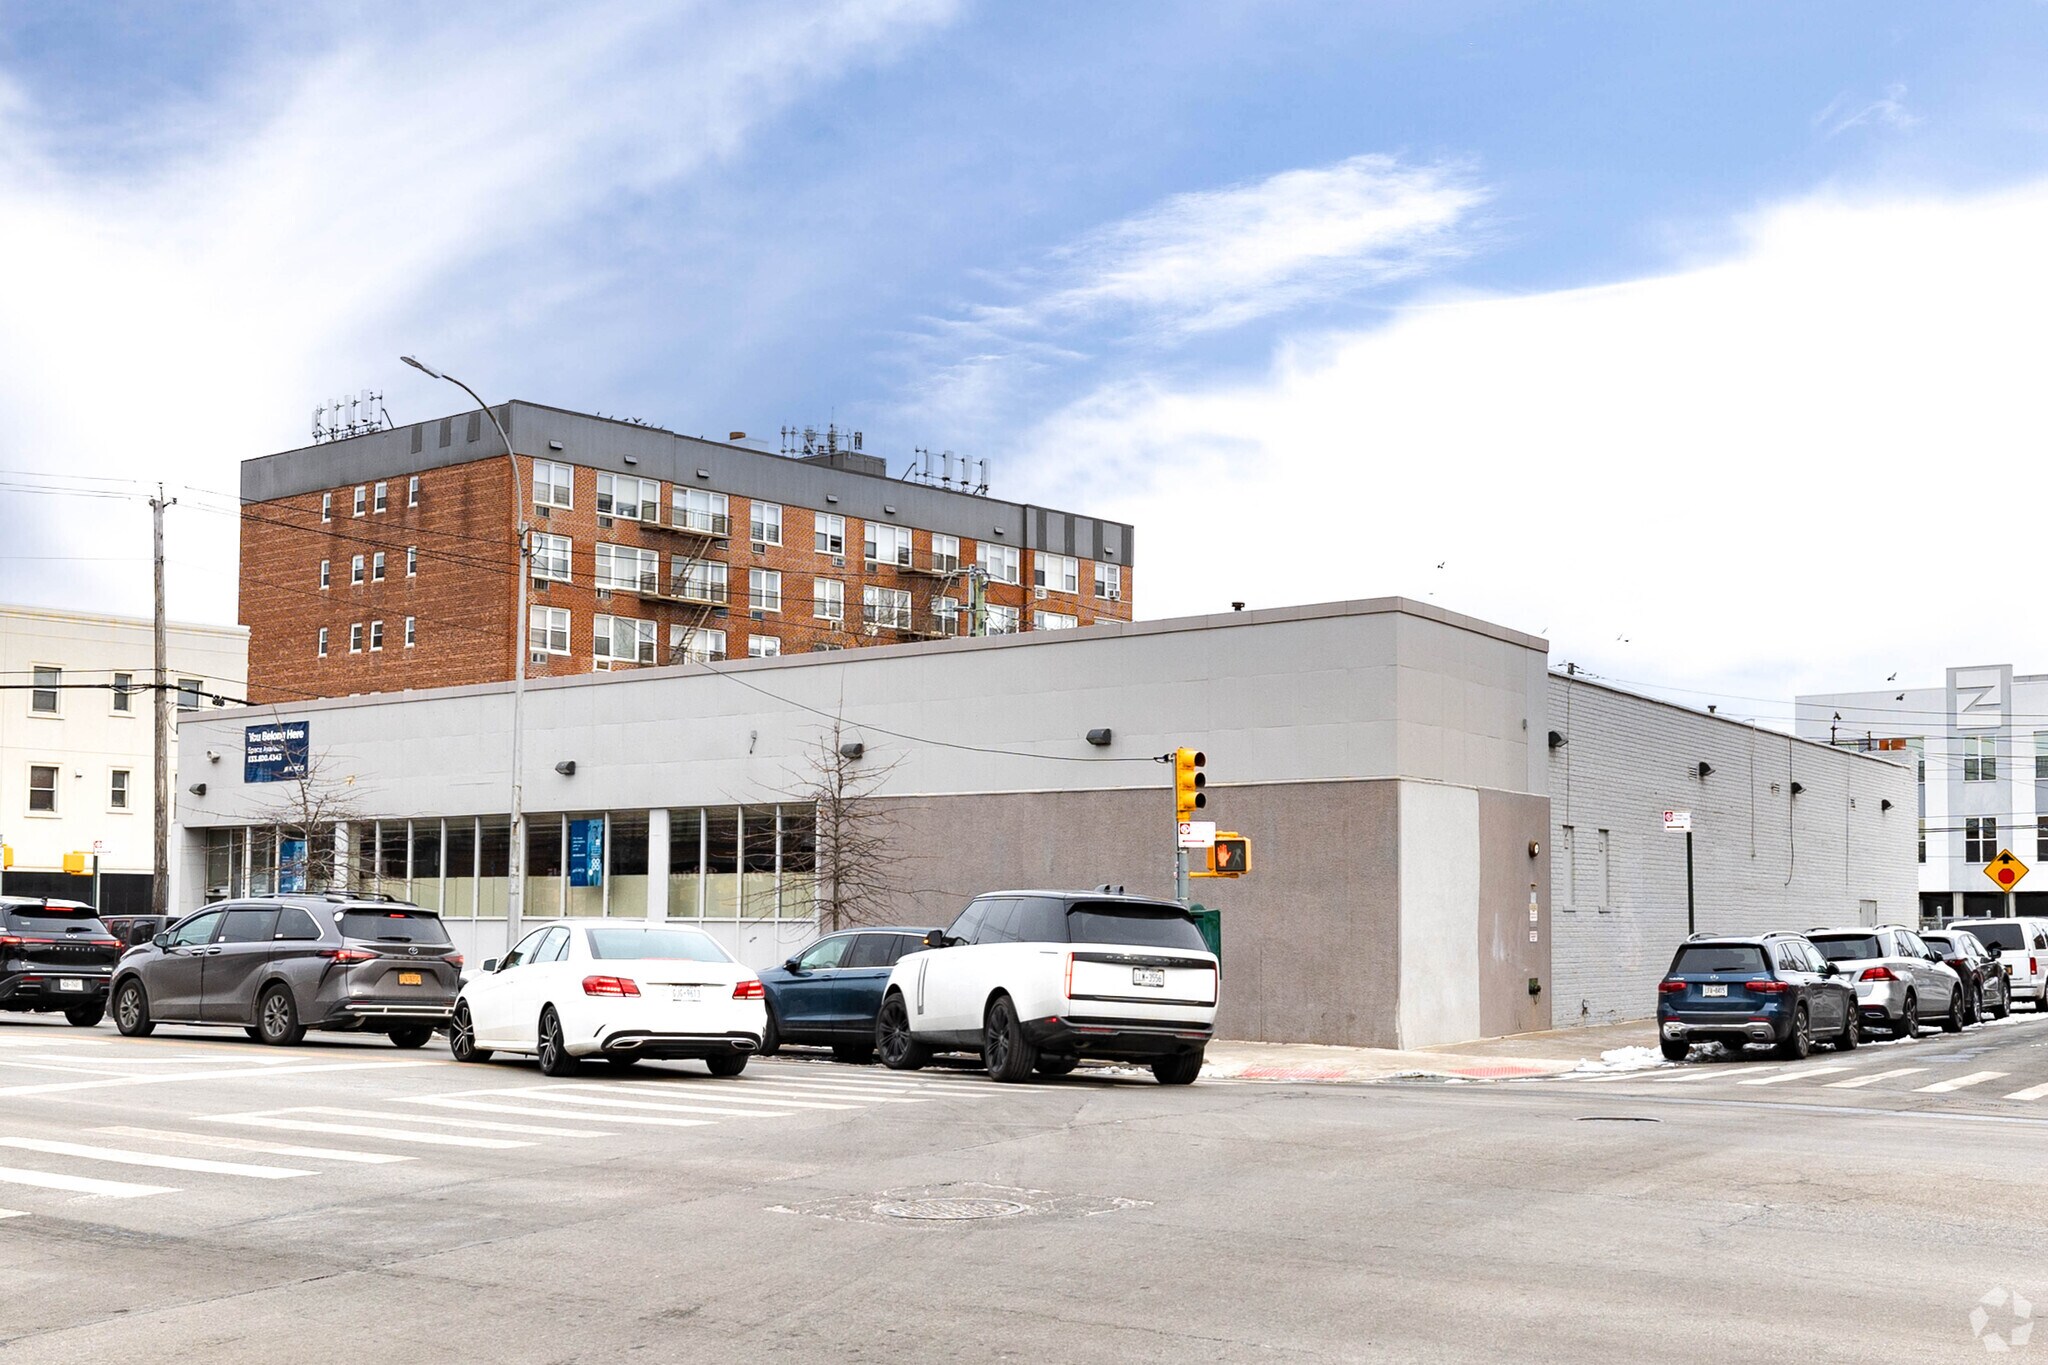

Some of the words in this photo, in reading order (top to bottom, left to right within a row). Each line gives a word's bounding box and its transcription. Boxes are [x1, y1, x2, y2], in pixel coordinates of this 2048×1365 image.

[248, 732, 261, 743] You
[262, 730, 285, 742] Belong
[287, 729, 305, 740] Here
[248, 746, 263, 754] Space
